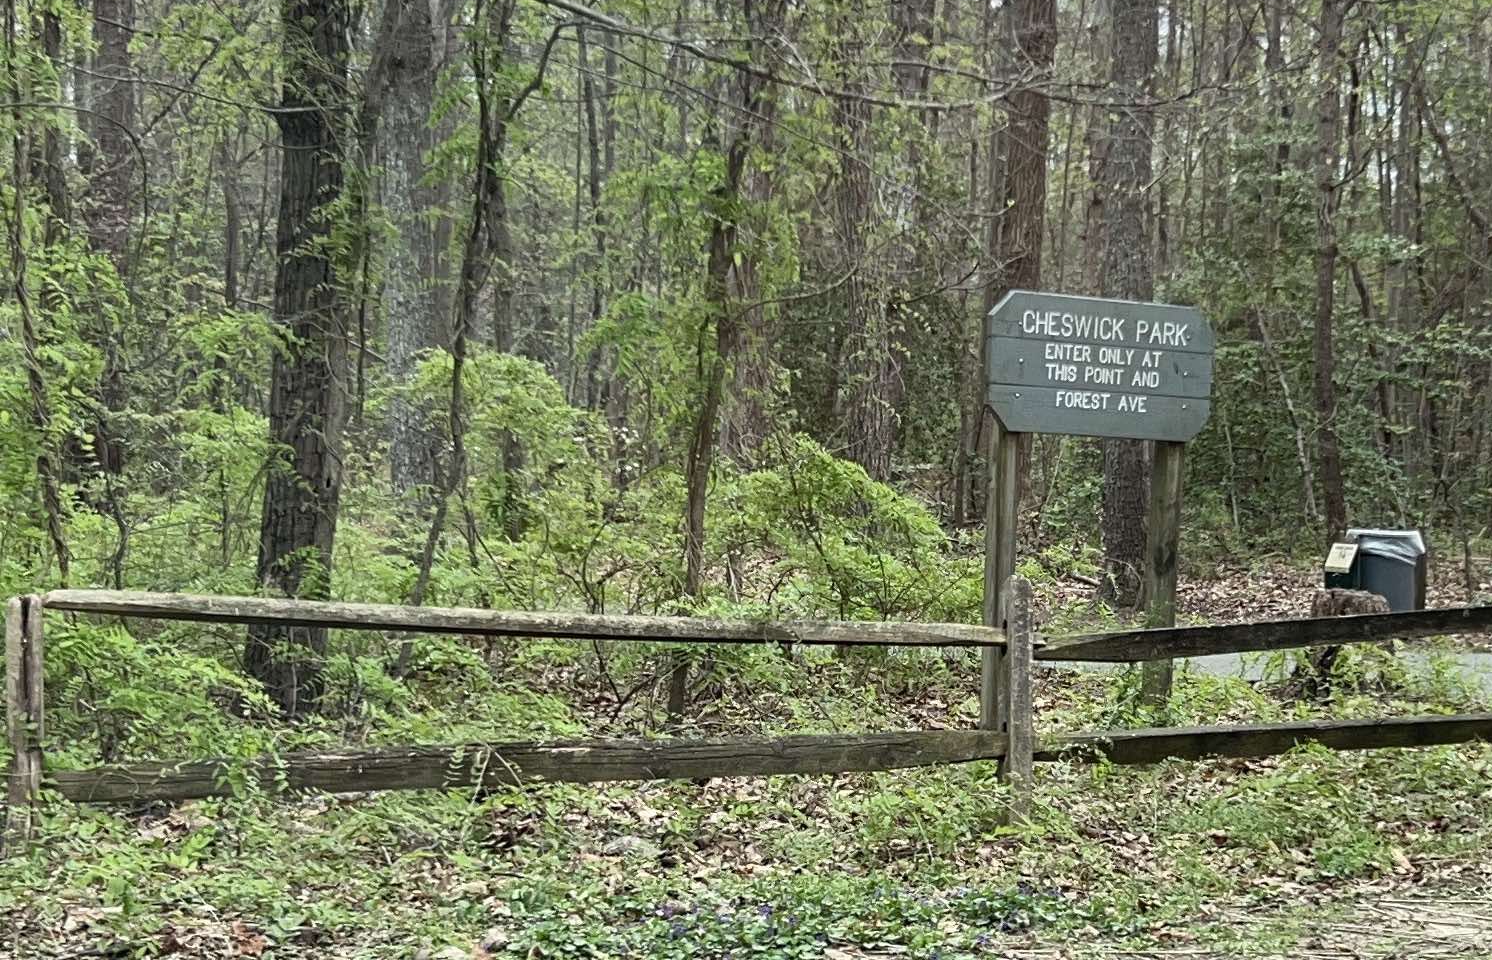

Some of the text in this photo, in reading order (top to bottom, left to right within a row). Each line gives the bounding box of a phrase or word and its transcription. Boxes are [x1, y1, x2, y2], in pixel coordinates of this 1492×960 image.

[1022, 310, 1188, 346] CHESWICK PARK
[1045, 343, 1162, 368] ENTER ONLY AT
[1045, 363, 1159, 388] THIS POINT AND
[1056, 391, 1147, 413] FOREST AVE
